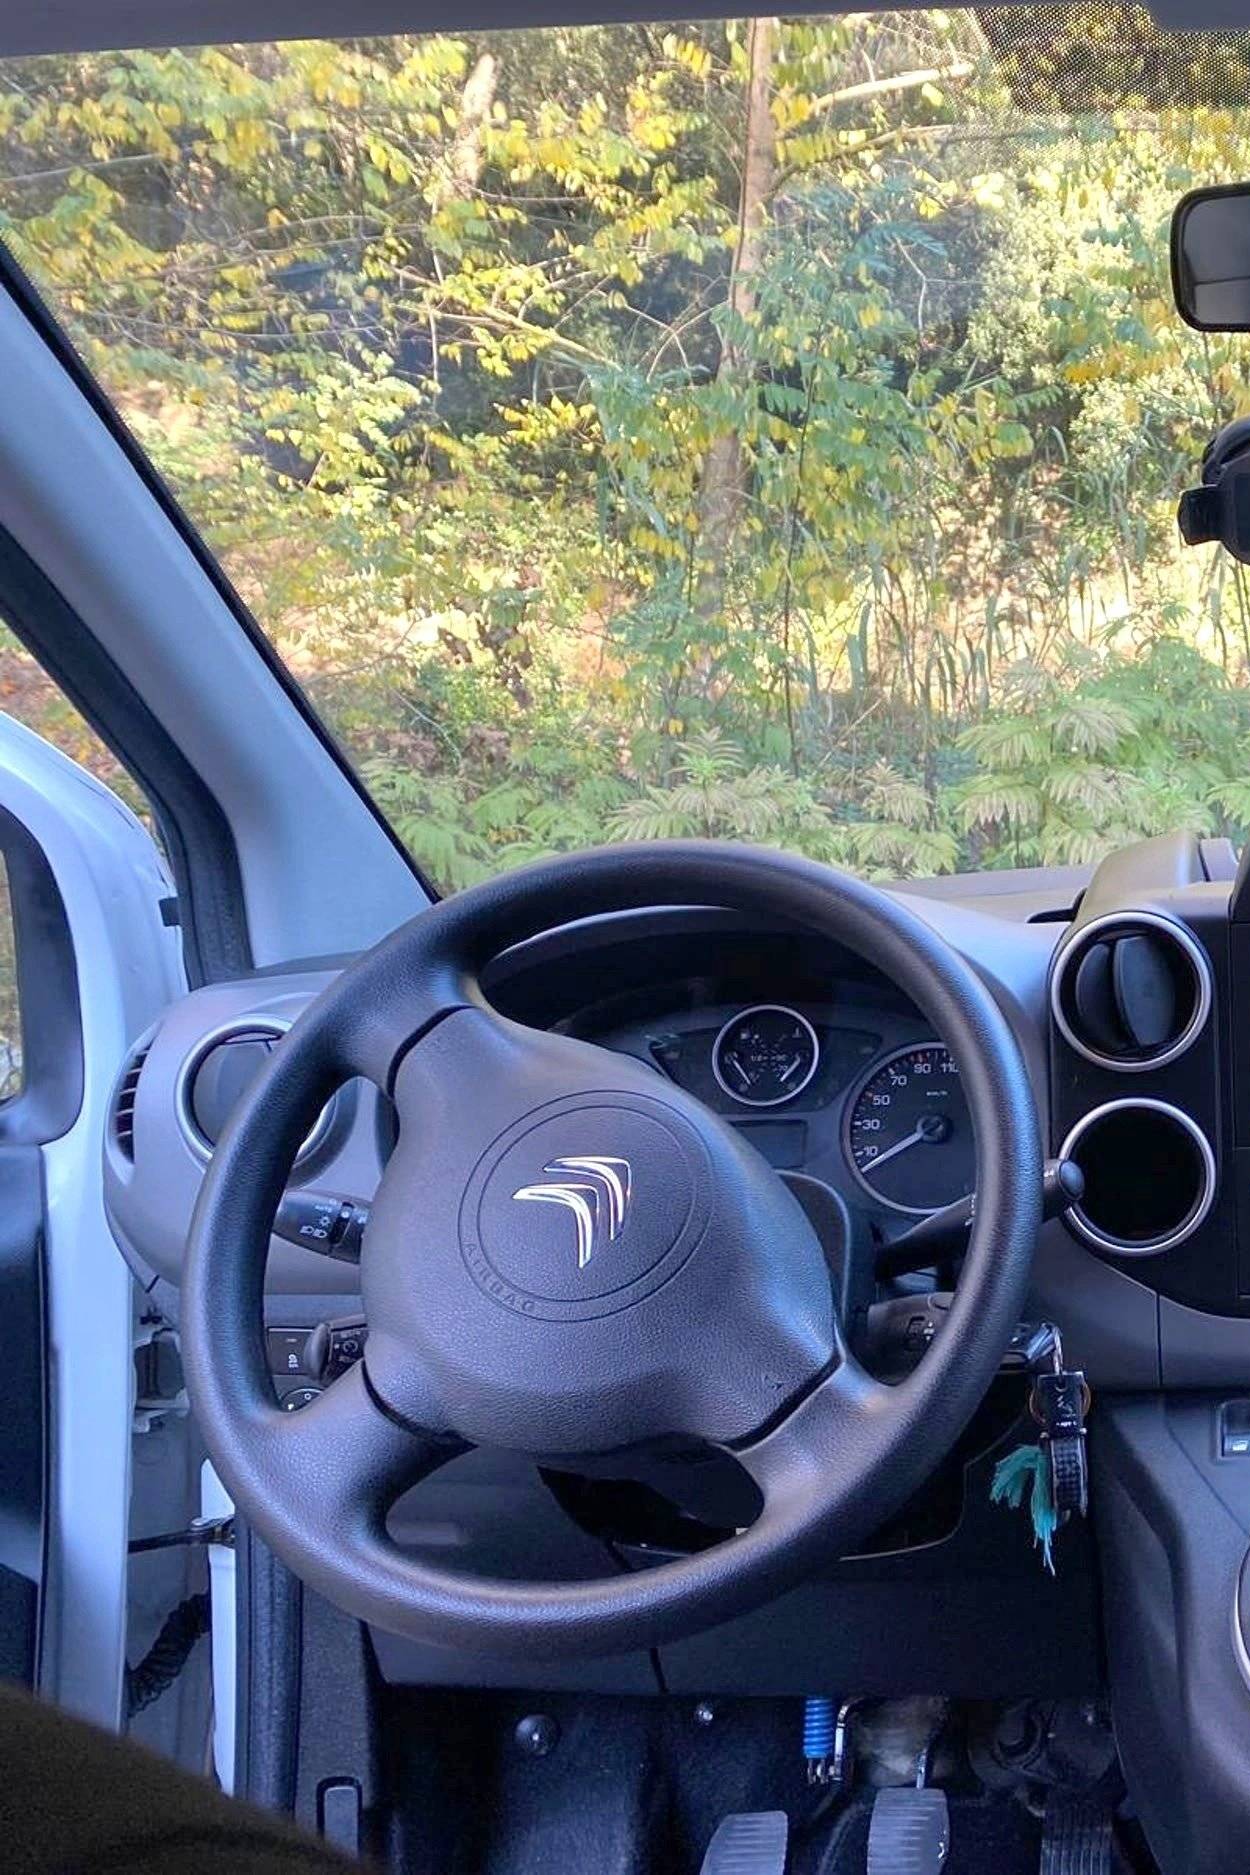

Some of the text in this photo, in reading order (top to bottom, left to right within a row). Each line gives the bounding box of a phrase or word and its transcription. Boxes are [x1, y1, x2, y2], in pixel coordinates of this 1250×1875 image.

[913, 1063, 932, 1074] 90
[890, 1075, 907, 1086] 70
[872, 1095, 890, 1106] 50
[862, 1119, 880, 1130] 30
[863, 1146, 878, 1157] 10
